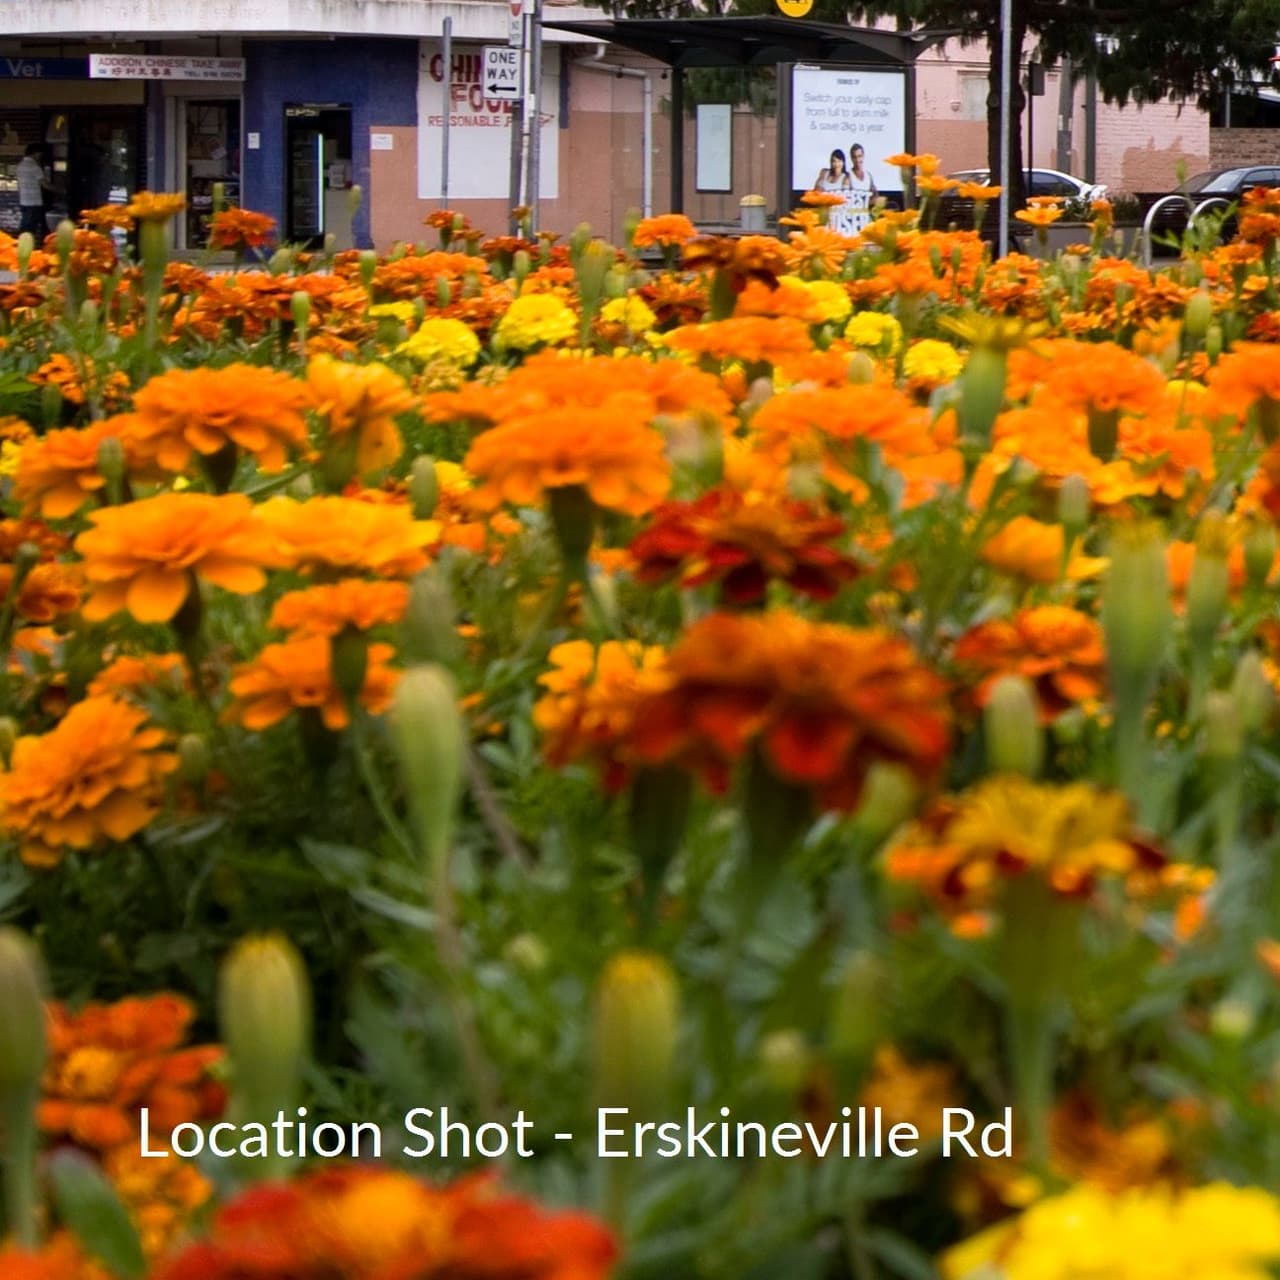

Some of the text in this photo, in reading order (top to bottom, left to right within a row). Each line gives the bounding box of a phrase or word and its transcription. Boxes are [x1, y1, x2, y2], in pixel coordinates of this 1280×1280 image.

[98, 57, 142, 68] ADDISON
[145, 58, 187, 69] CHINESE
[488, 51, 517, 64] ONE
[5, 58, 43, 78] Vet
[429, 53, 484, 82] CHIN
[487, 67, 518, 80] WAY
[428, 115, 500, 127] RESONABLE
